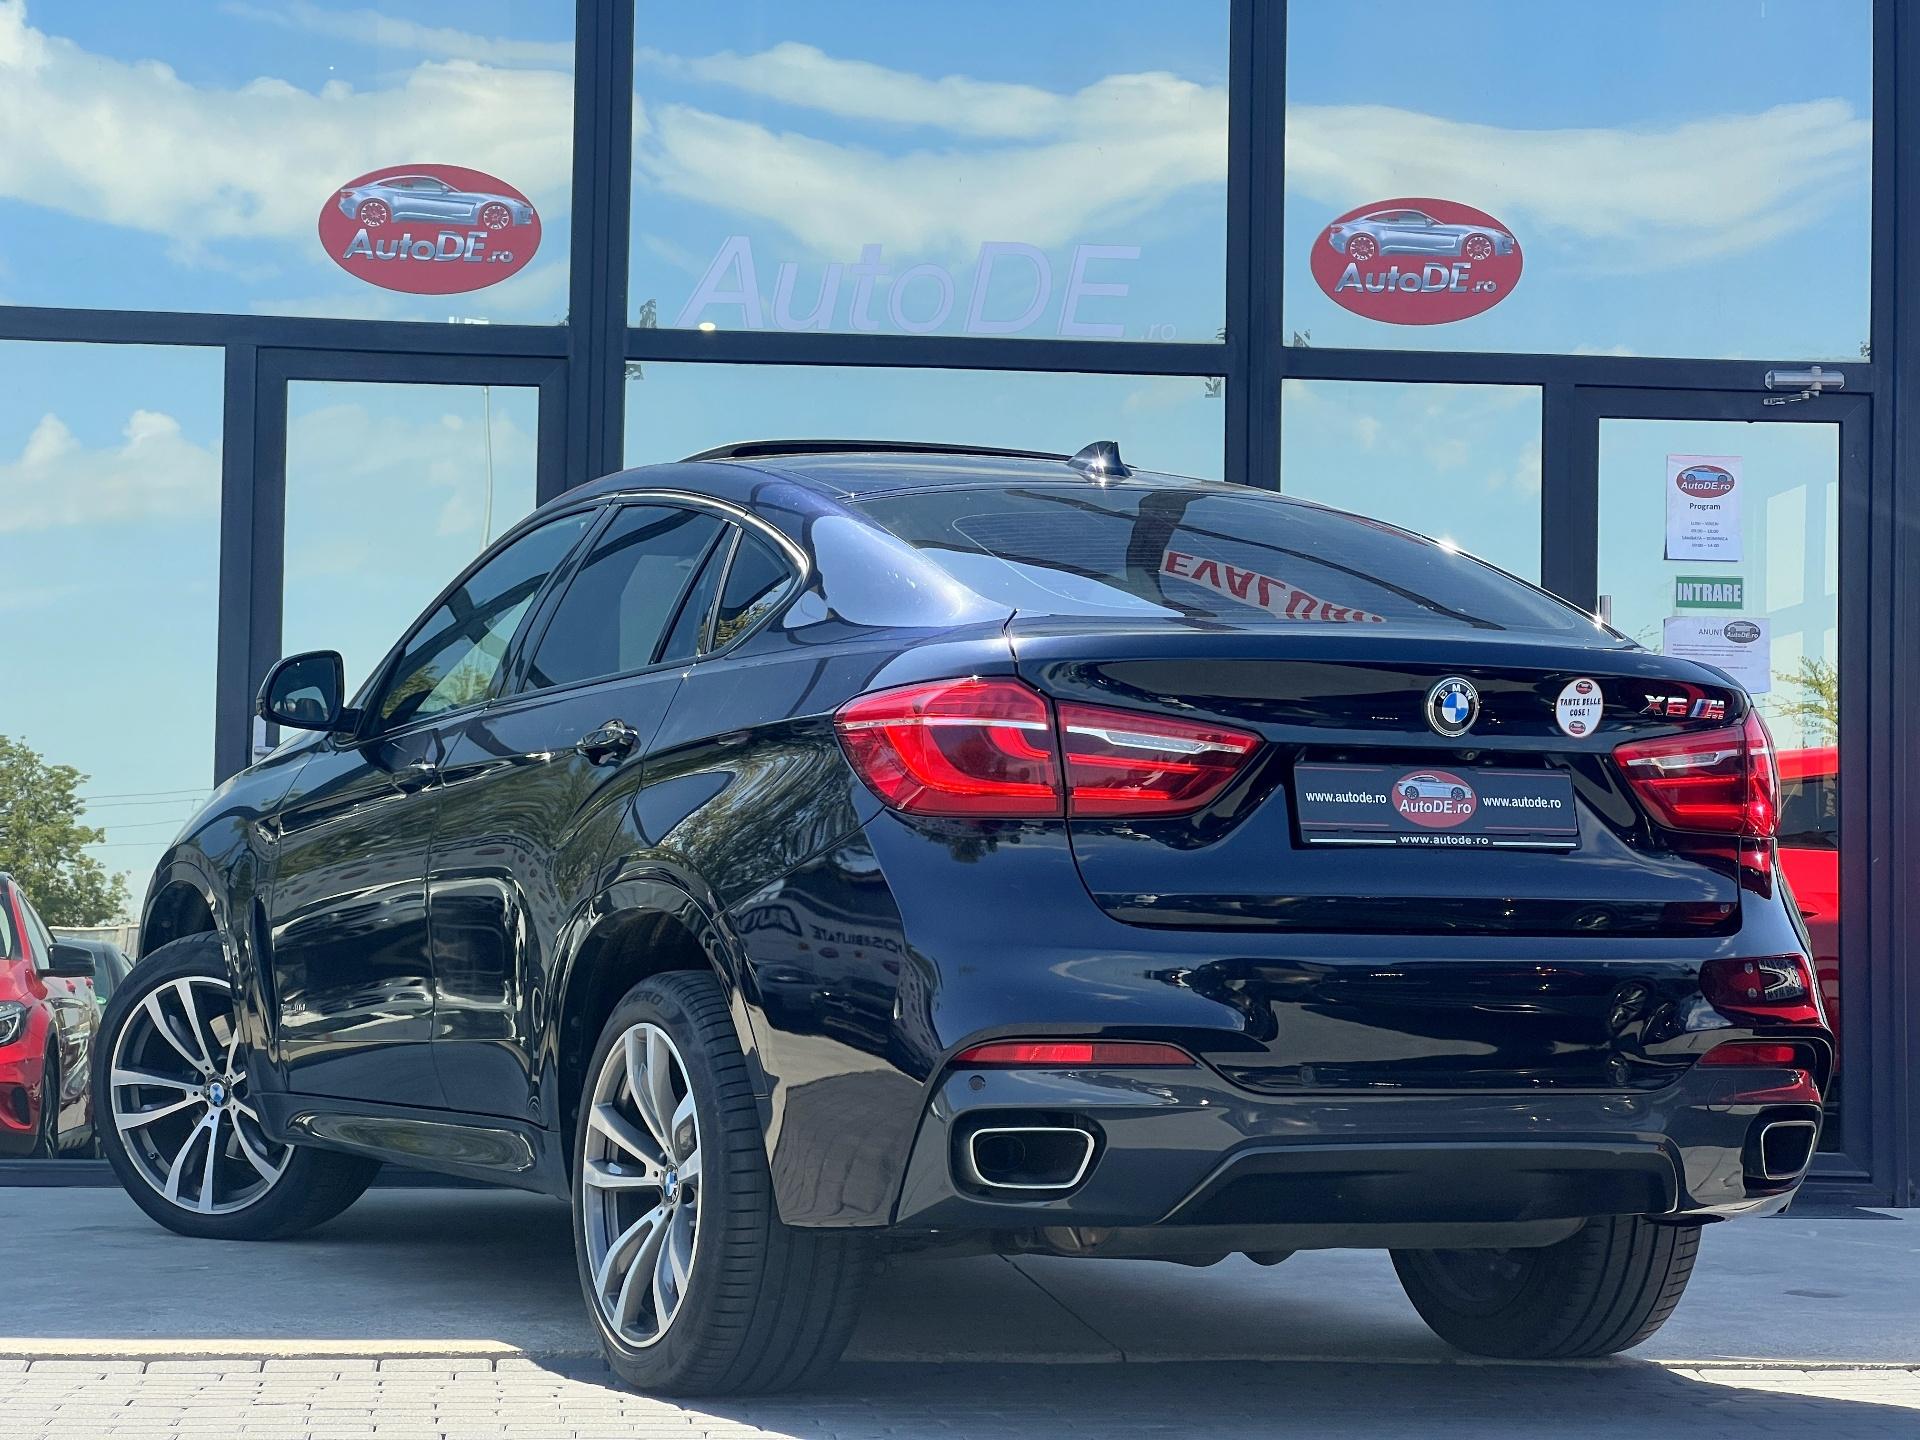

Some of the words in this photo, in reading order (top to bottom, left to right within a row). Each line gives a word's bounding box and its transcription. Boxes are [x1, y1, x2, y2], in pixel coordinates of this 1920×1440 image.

[1681, 481, 1731, 491] AutoDE.ro
[1689, 502, 1721, 511] Program
[1677, 583, 1742, 602] INTRARE
[1560, 698, 1580, 707] TANTE
[1582, 697, 1601, 706] BELLE
[1306, 791, 1387, 804] www.autode.ro
[1482, 797, 1562, 809] www.autode.ro
[1400, 799, 1472, 814] AutoDE.ro
[1400, 835, 1489, 845] www.autode.ro
